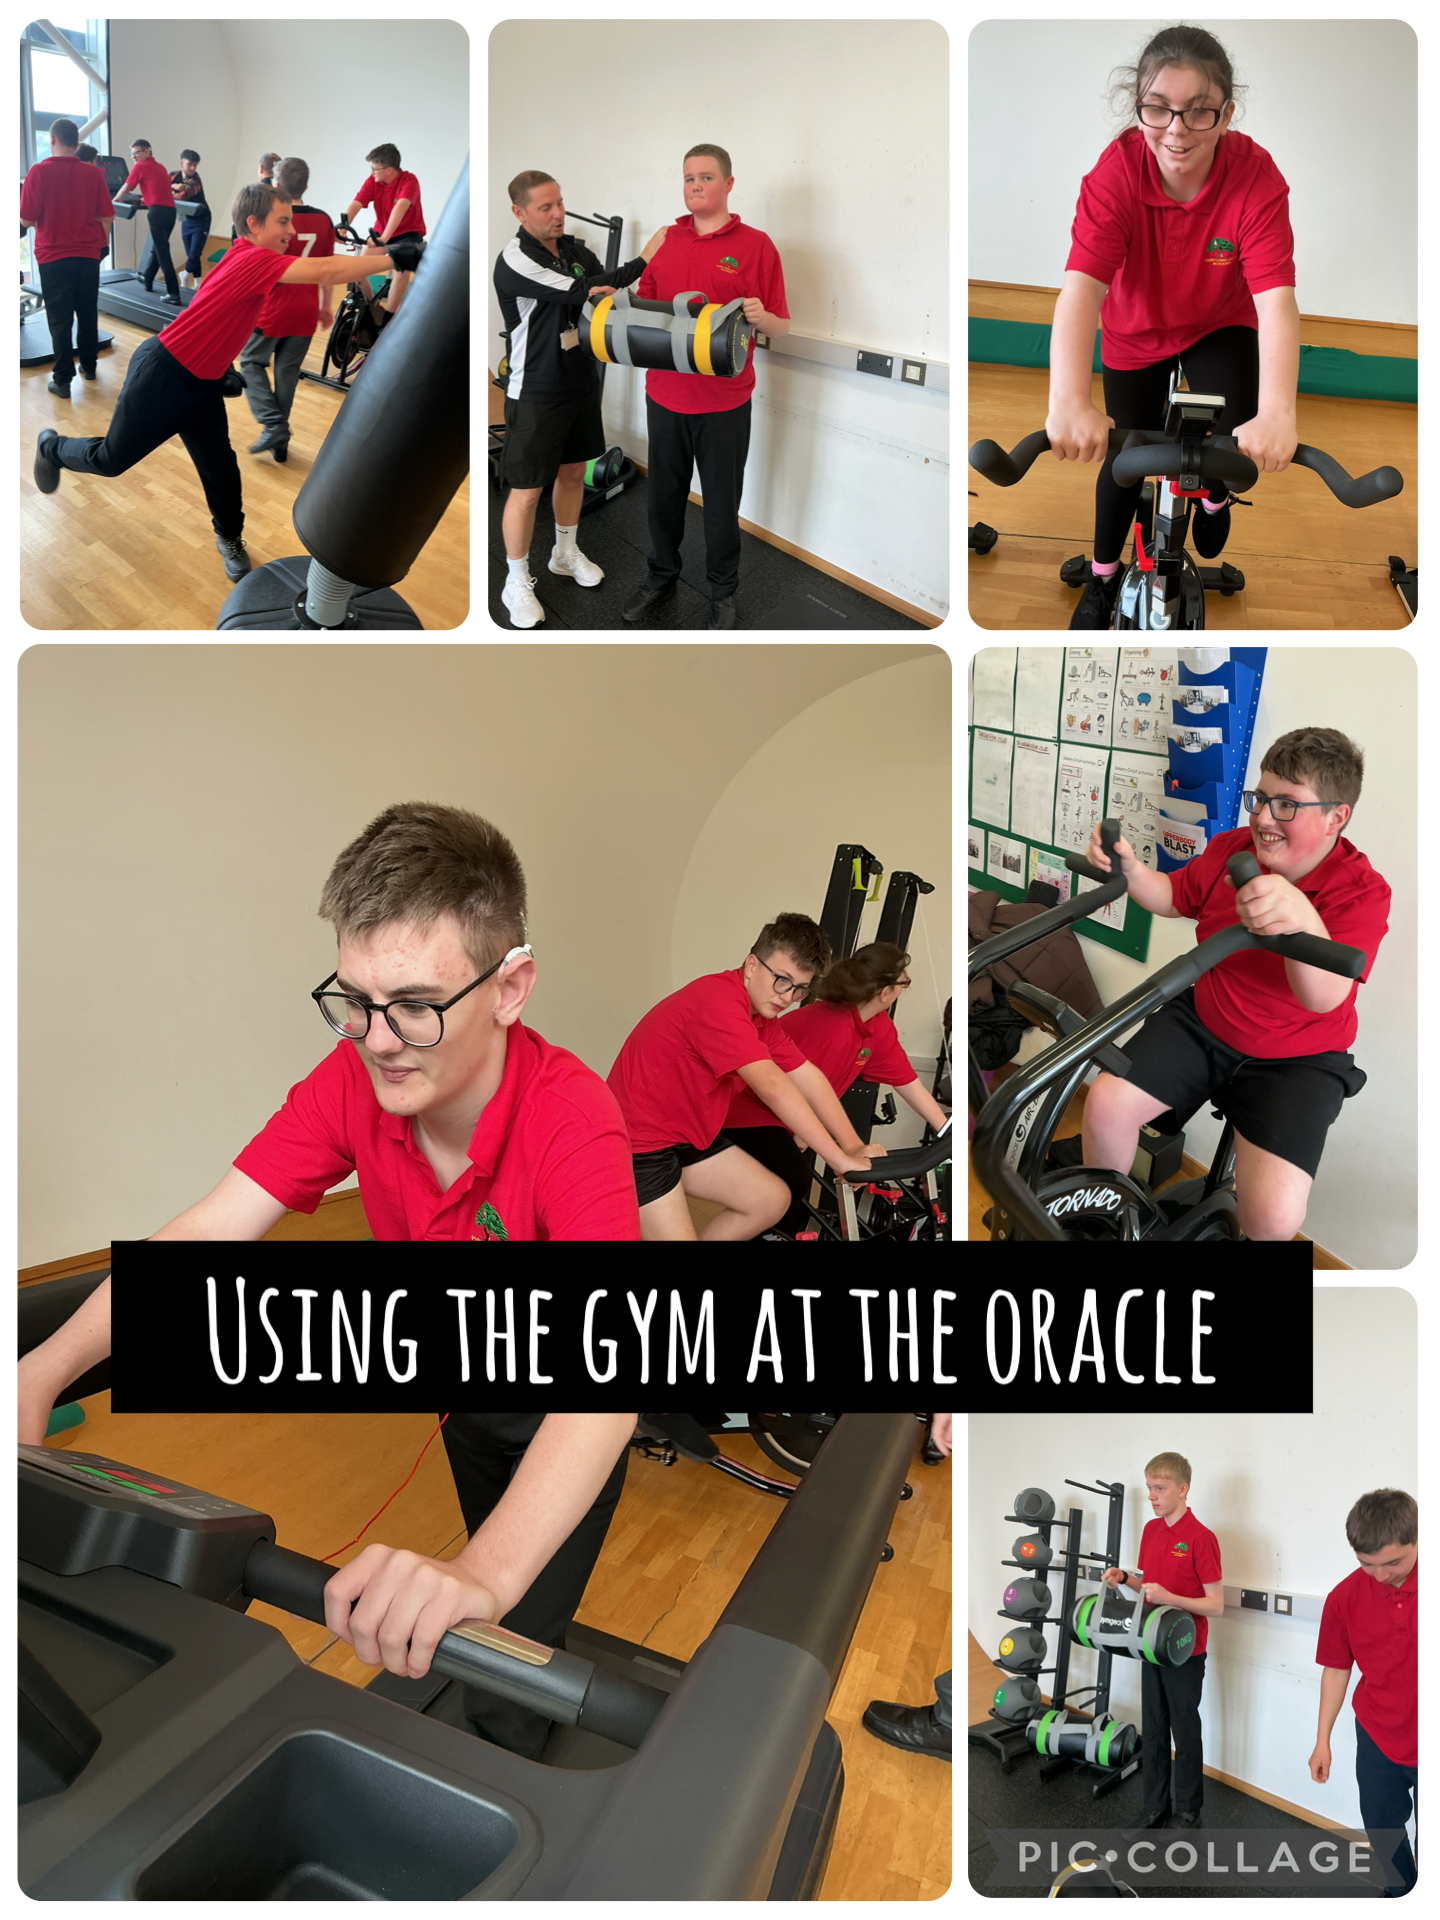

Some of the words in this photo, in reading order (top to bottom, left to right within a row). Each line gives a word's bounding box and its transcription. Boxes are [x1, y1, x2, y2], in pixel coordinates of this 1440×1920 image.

[297, 233, 317, 258] 7
[1163, 830, 1196, 845] UPPERBODY
[1163, 837, 1197, 855] BLAST
[1045, 1186, 1122, 1217] TORNADO
[1176, 1632, 1193, 1650] 10KG
[996, 1690, 1002, 1698] 7
